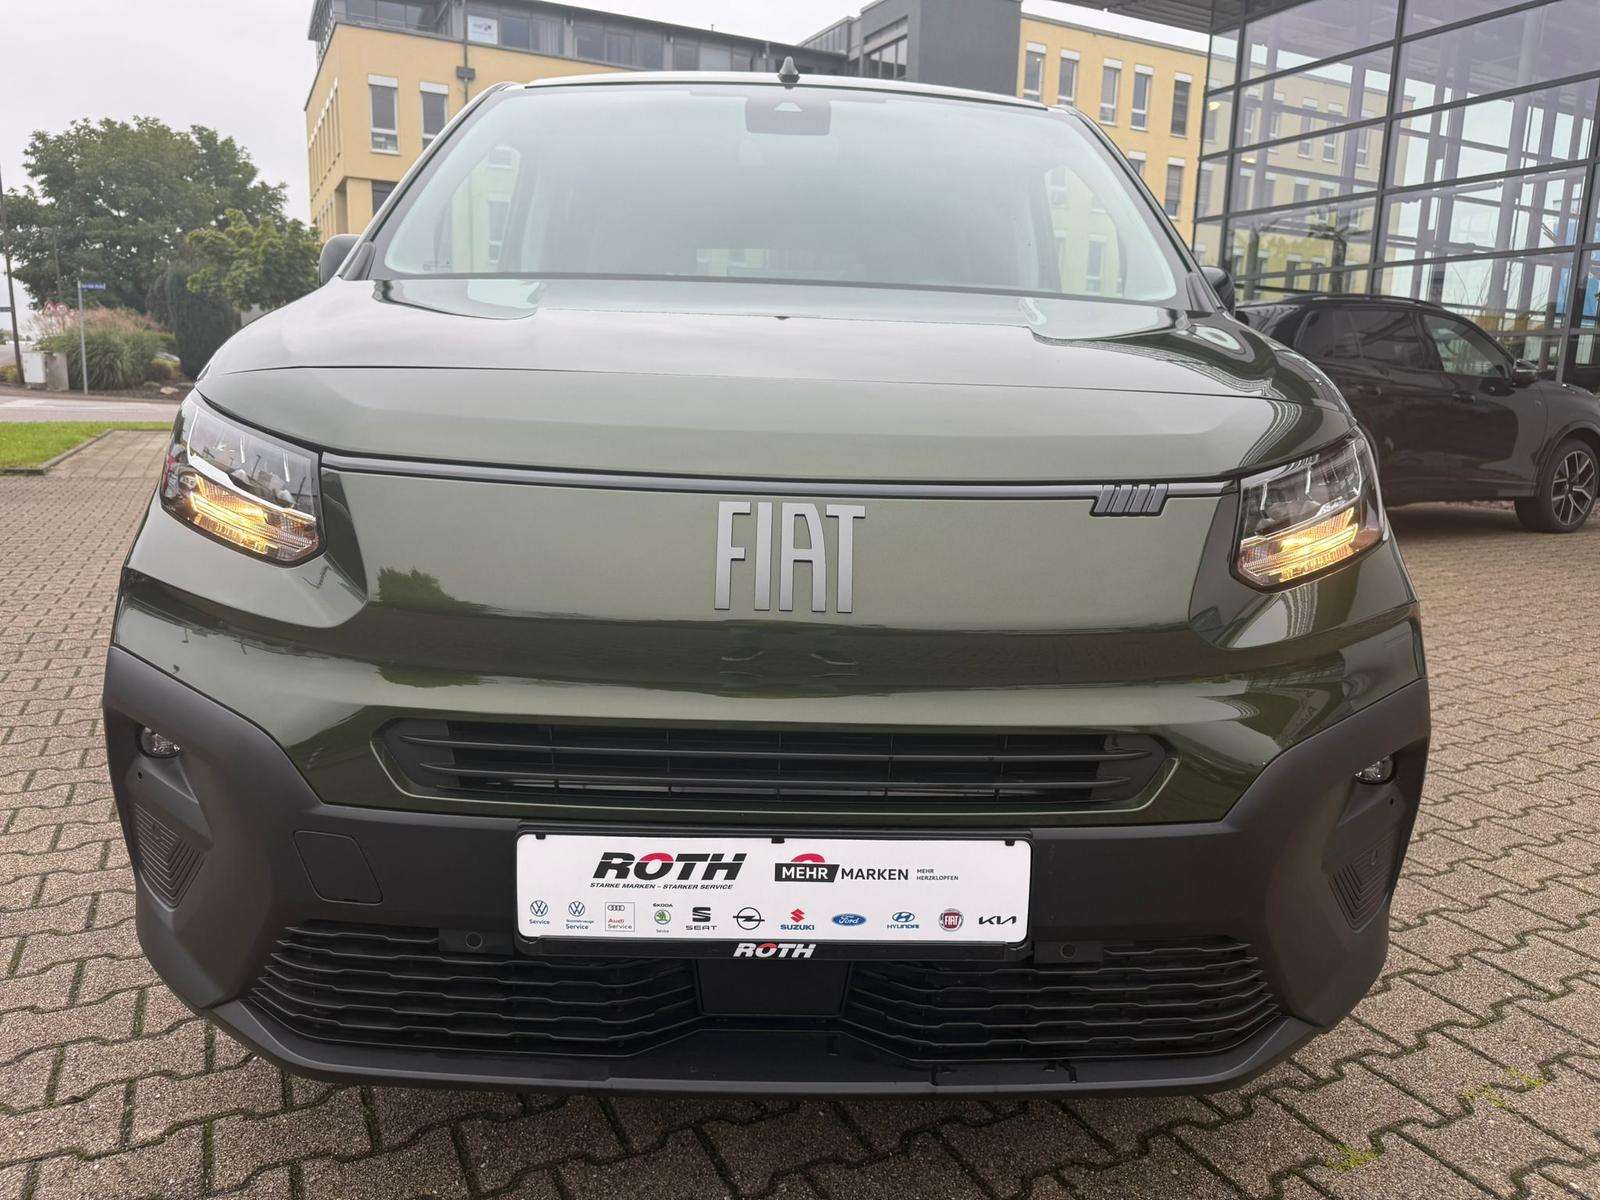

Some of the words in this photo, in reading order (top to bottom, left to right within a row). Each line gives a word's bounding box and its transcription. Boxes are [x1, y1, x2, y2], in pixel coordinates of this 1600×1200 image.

[714, 501, 866, 613] FIAT
[593, 852, 748, 881] ROTH
[782, 866, 829, 880] MEHR
[841, 868, 908, 881] MARKEN
[945, 916, 959, 927] FIAT
[733, 942, 817, 958] ROTH
